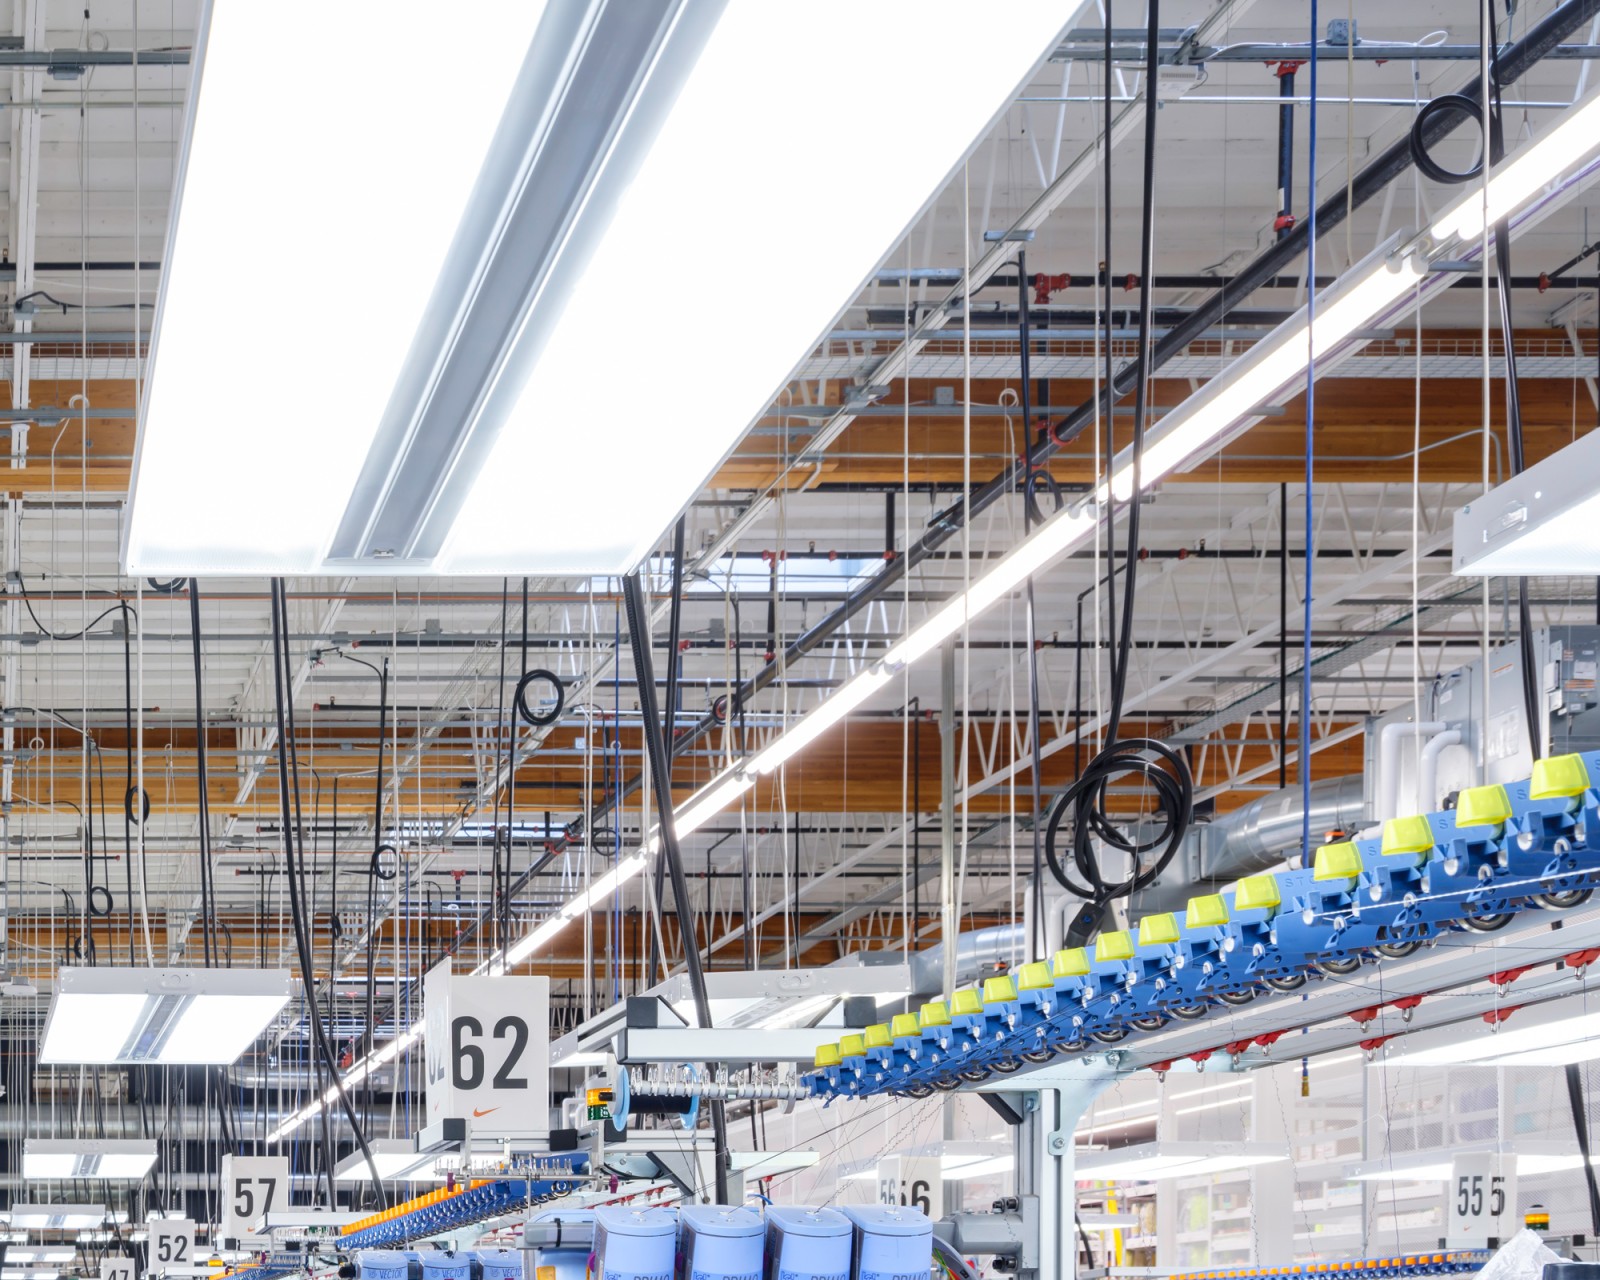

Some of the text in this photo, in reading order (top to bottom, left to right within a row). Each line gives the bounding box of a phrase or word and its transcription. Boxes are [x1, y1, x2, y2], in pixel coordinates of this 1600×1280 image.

[451, 1015, 529, 1091] 62
[234, 1178, 277, 1218] 57
[1457, 1175, 1483, 1217] 55
[157, 1234, 189, 1262] 52
[379, 1269, 403, 1279] VECTOR
[442, 1268, 465, 1278] VECTOR
[503, 1268, 522, 1278] VECTO
